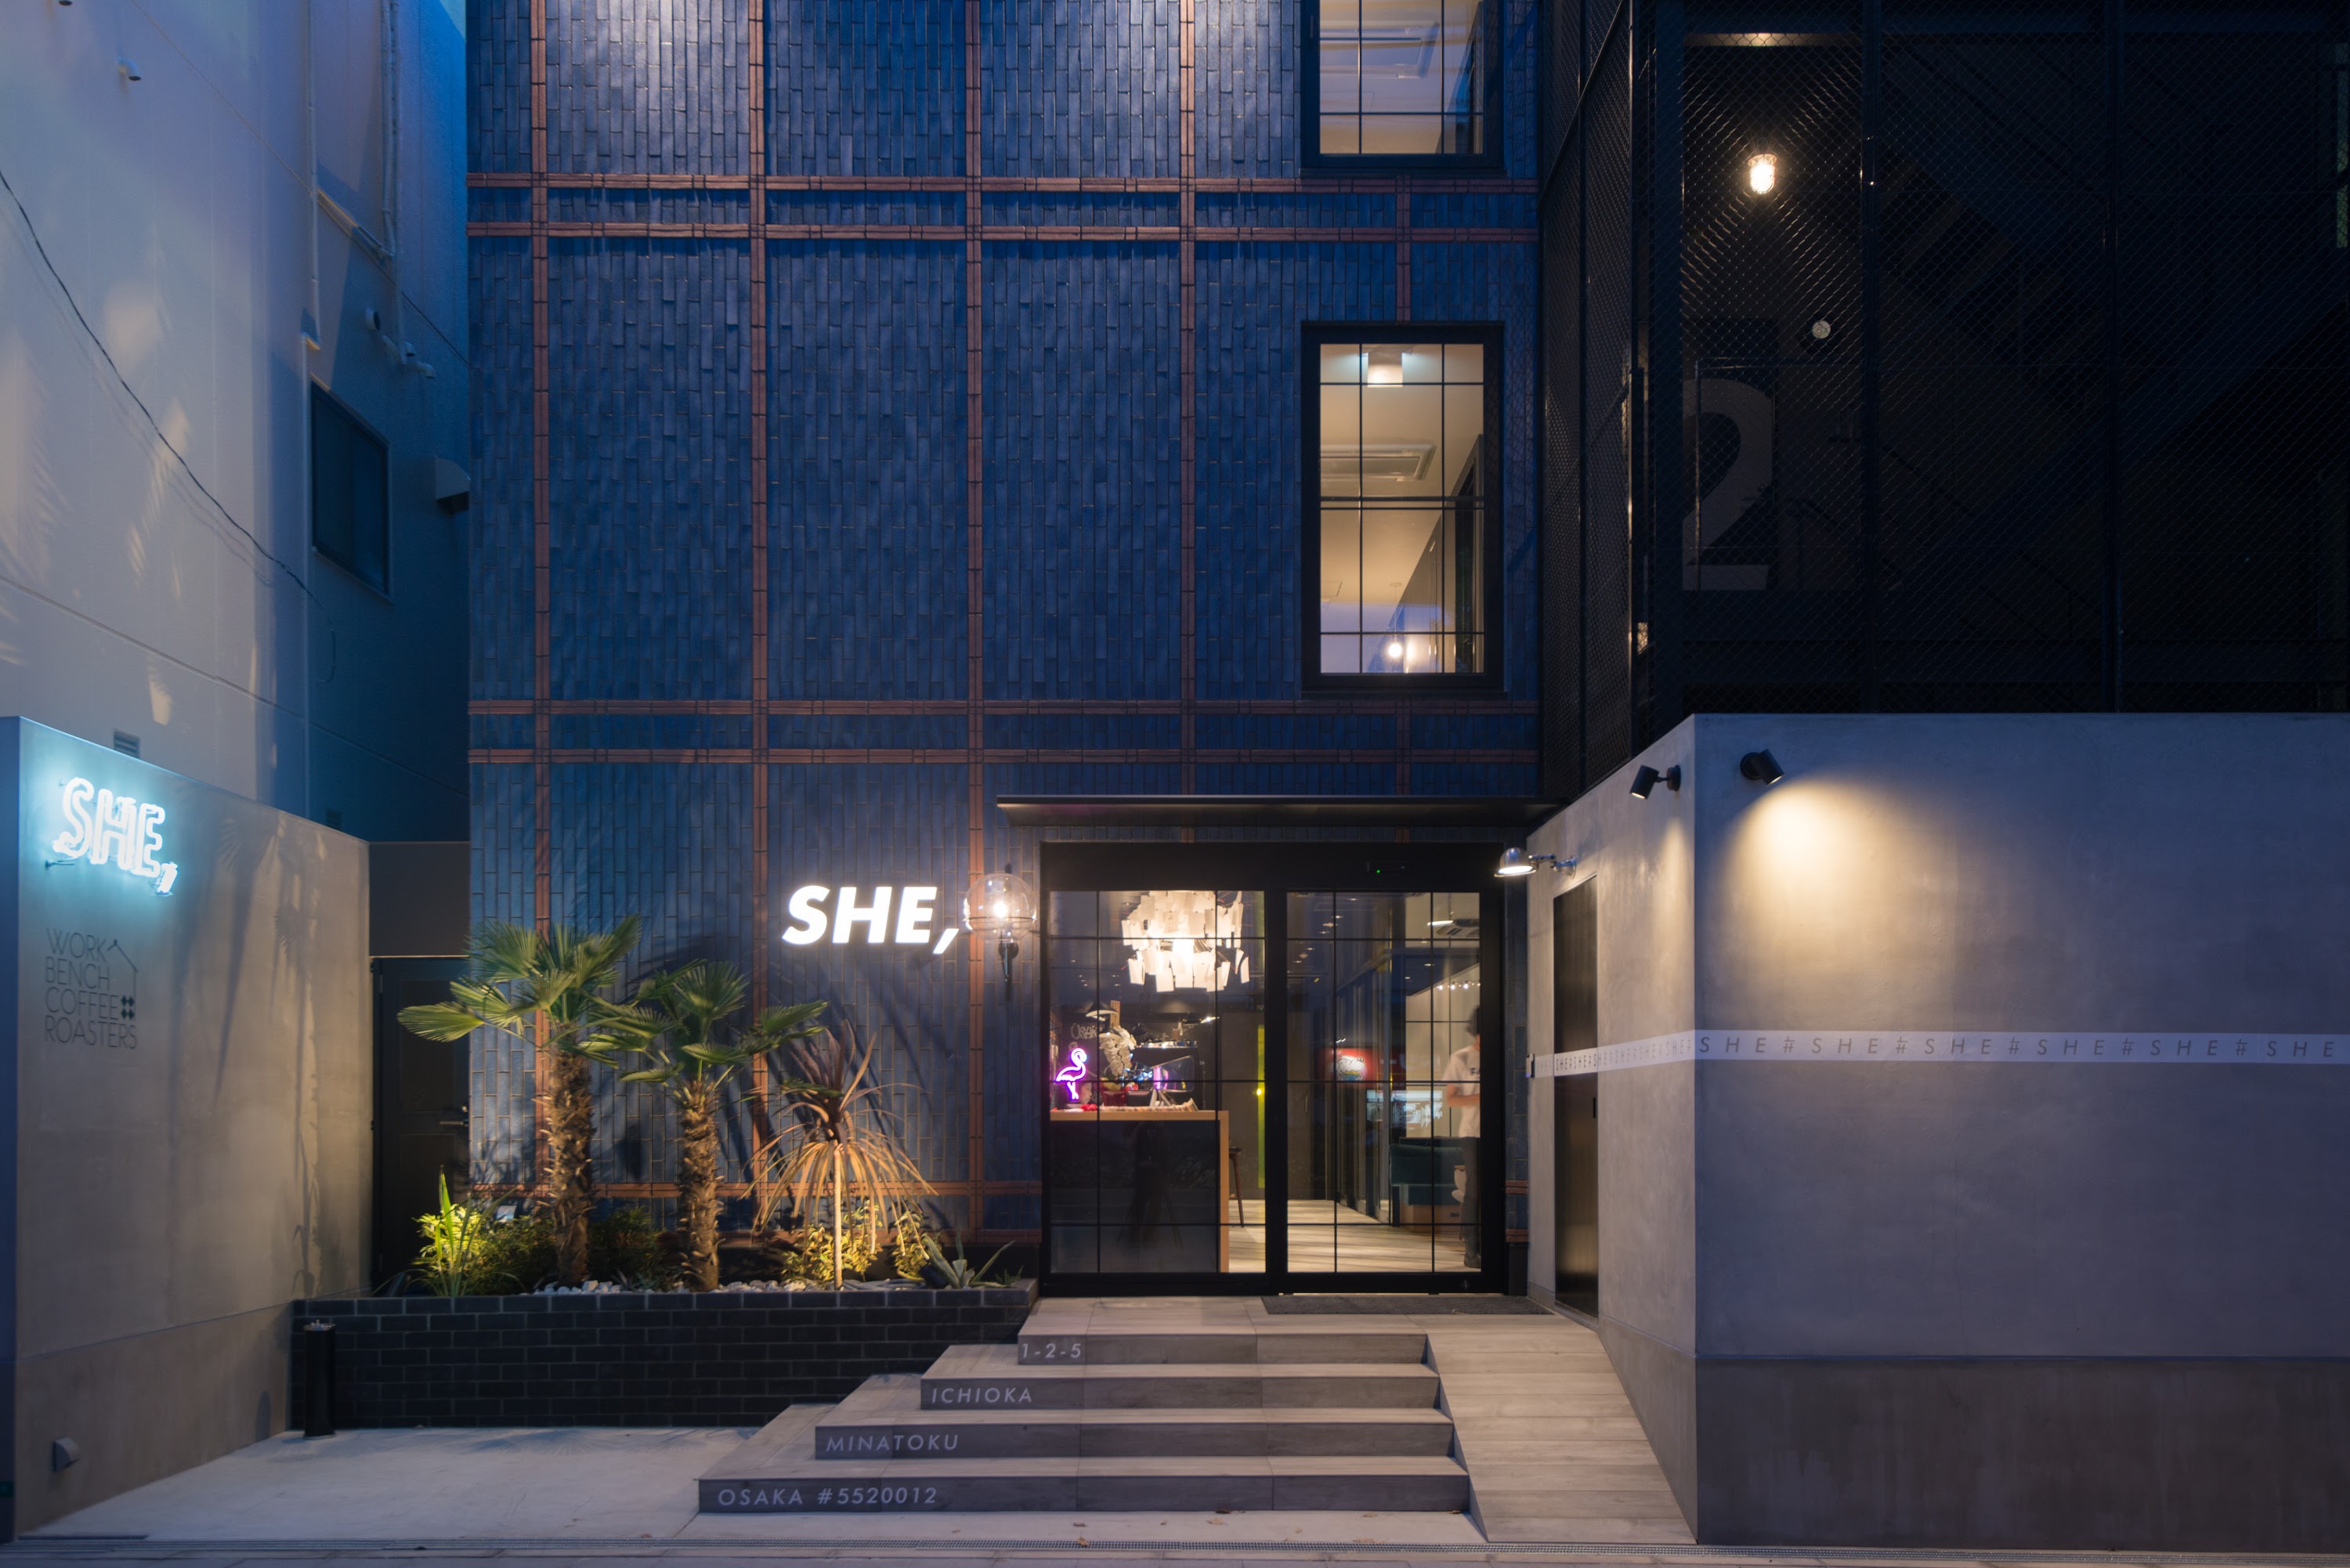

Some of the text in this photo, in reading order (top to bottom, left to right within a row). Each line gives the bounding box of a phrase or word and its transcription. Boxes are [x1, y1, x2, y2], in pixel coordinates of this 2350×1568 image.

[782, 885, 960, 955] SHE,
[45, 927, 107, 963] WORK
[45, 956, 110, 991] BENCH
[45, 986, 120, 1020] COFFEE
[44, 1015, 138, 1050] ROASTERS
[1021, 1342, 1082, 1358] 1-2-5
[931, 1387, 1032, 1404] ICHIOKA
[826, 1434, 959, 1451] MINATOKU
[717, 1487, 937, 1505] OSAKA #5520012
